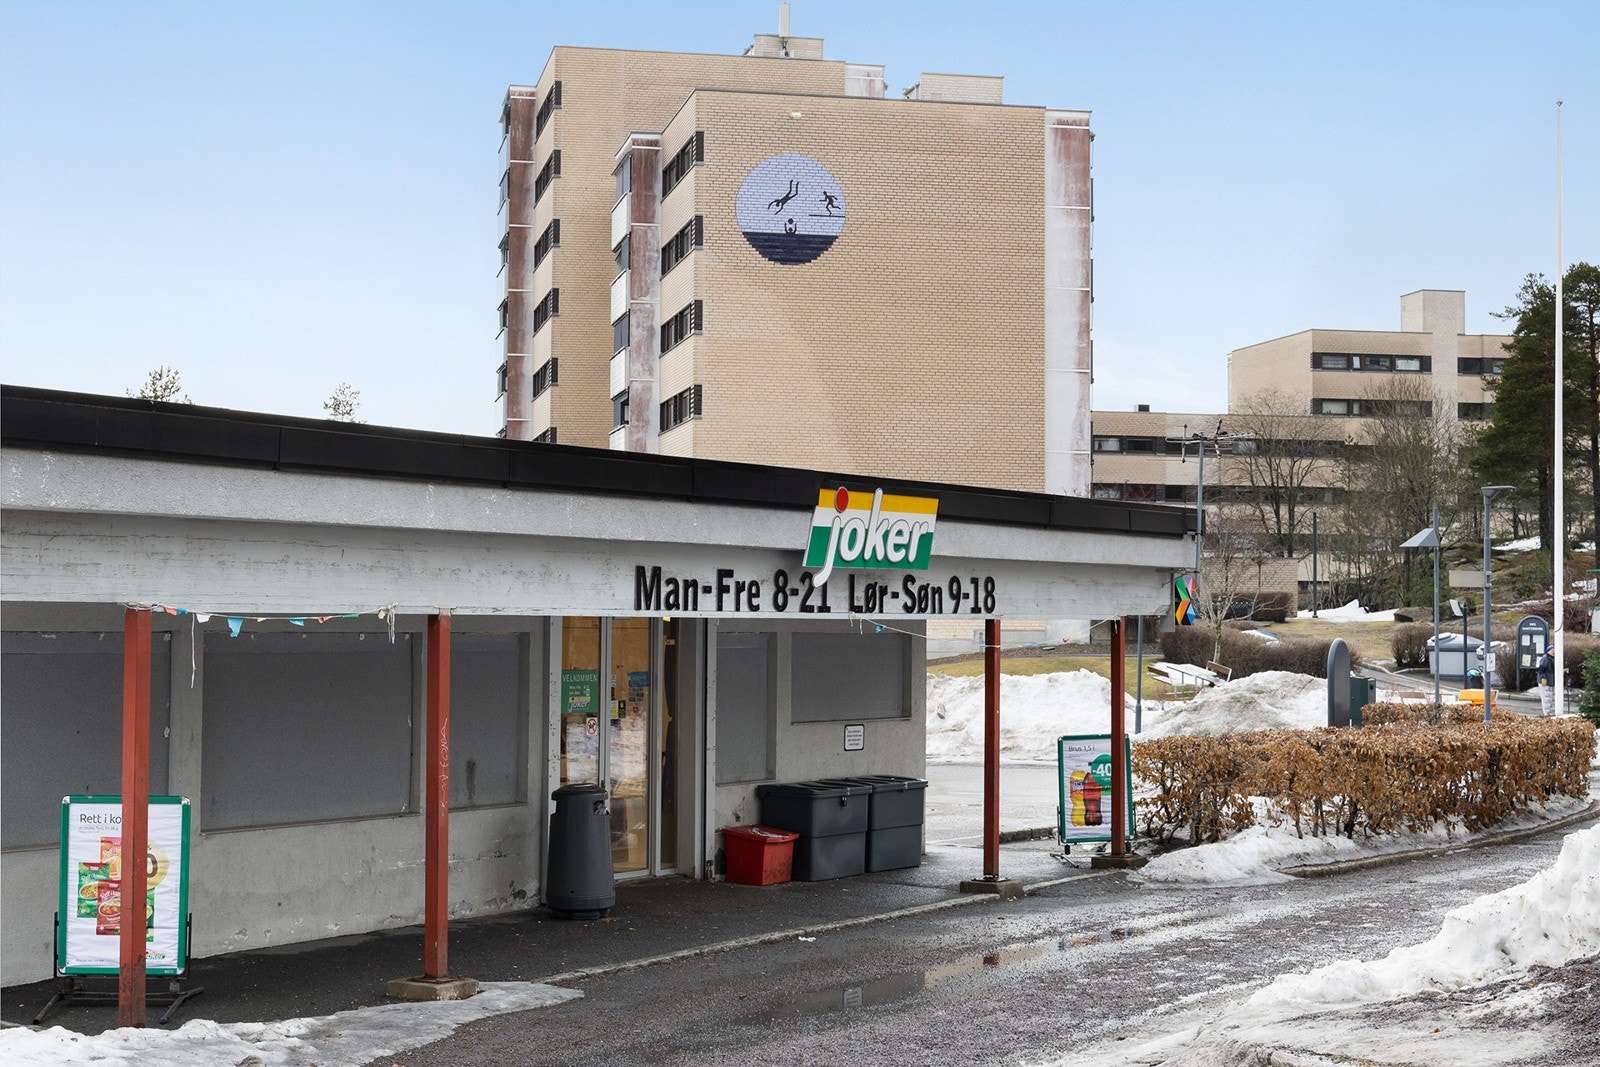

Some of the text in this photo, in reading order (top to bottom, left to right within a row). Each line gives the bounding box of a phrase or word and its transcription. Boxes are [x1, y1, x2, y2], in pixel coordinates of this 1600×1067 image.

[812, 486, 930, 588] joker
[634, 565, 996, 614] Man-Fre 8-21 Lør-Søn 9-18
[562, 674, 598, 682] VELKOMMEN
[80, 813, 102, 824] Rett
[109, 813, 122, 824] ko
